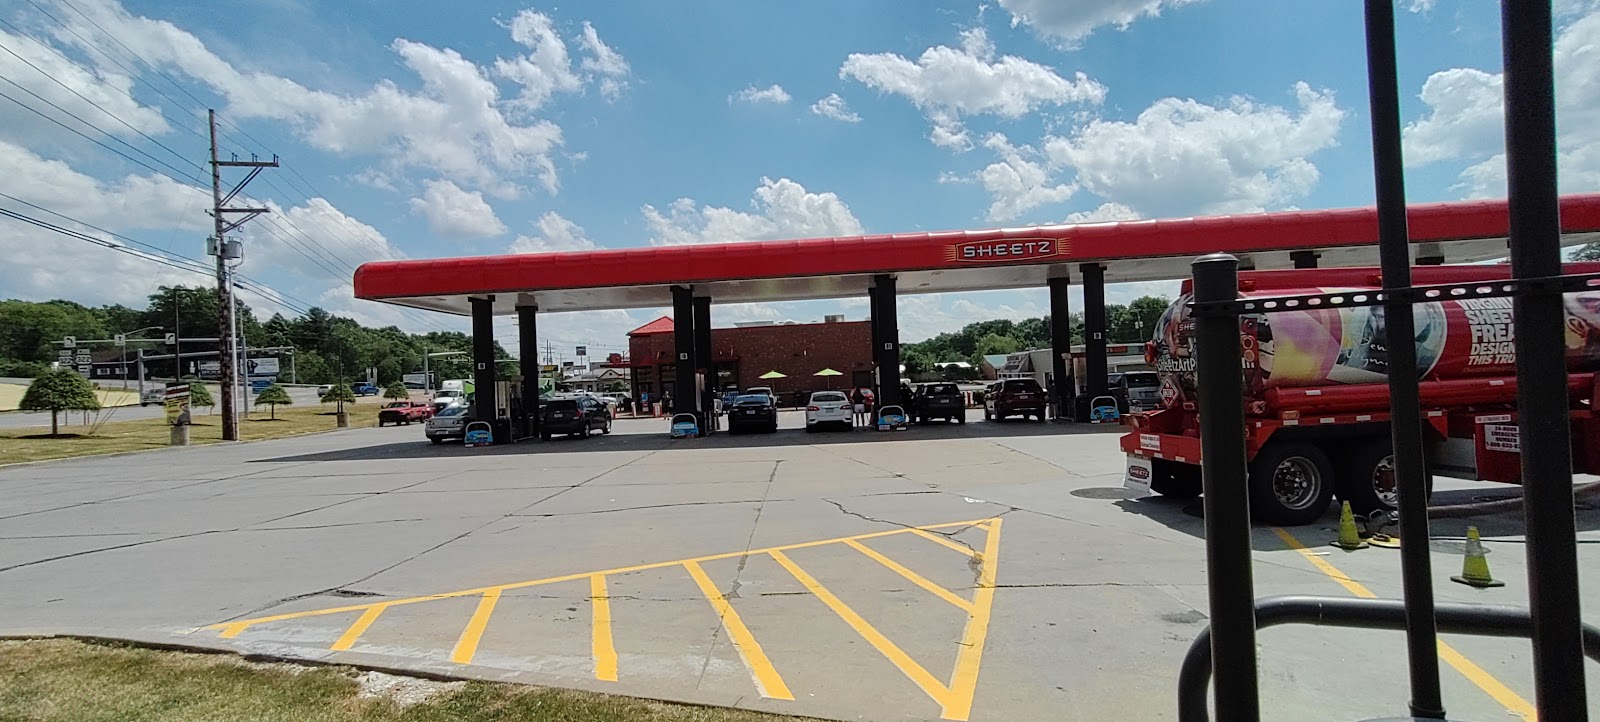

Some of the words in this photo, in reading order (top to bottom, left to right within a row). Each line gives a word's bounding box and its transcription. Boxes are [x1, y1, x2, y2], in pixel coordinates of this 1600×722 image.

[963, 241, 1050, 257] SHEETZ
[1455, 296, 1514, 310] VIRGINI
[1468, 354, 1494, 366] THIS
